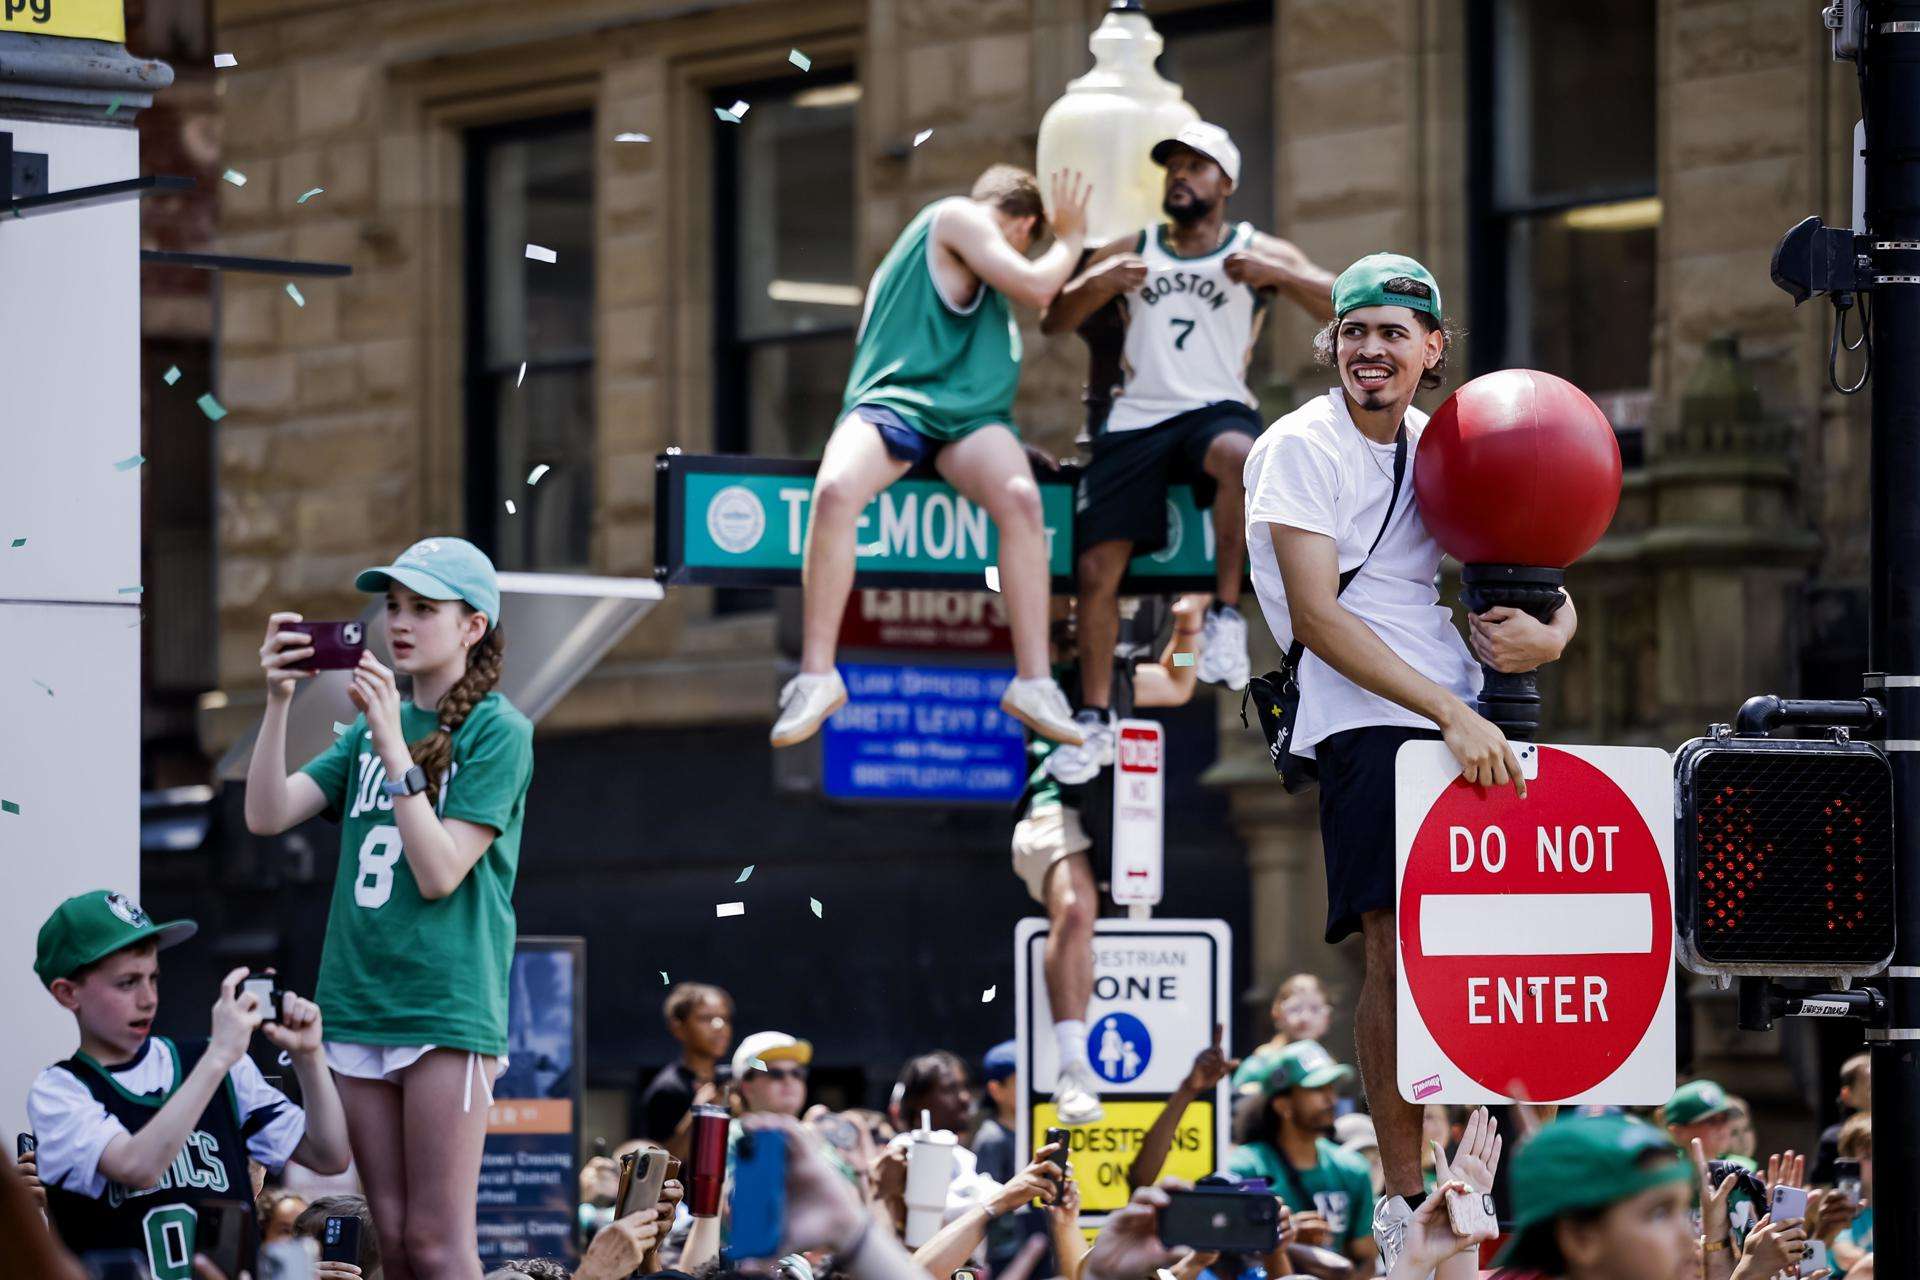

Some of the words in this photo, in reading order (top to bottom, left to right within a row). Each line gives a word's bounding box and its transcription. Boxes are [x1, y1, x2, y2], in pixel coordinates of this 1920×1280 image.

[1141, 271, 1228, 312] BOSTON
[1170, 318, 1195, 350] 7
[780, 487, 988, 560] TEMON
[355, 824, 403, 909] 8
[1449, 825, 1507, 873] DO
[1536, 825, 1620, 873] NOT
[1093, 975, 1176, 1000] ONE
[1467, 975, 1609, 1025] ENTER
[142, 1202, 198, 1280] 0
